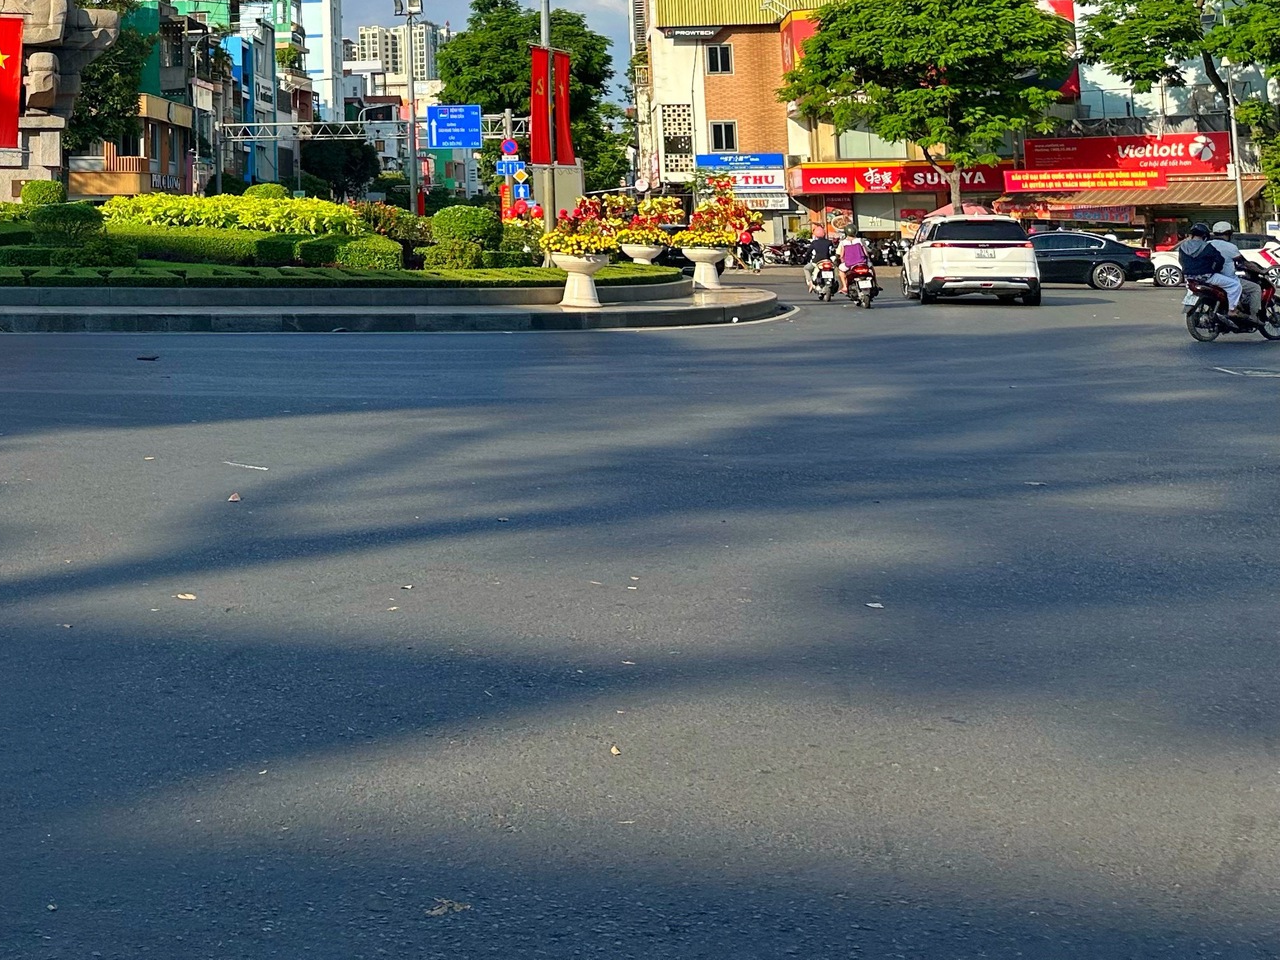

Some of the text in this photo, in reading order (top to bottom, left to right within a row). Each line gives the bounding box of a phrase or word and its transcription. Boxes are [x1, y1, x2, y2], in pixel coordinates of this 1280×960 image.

[1117, 142, 1185, 158] Vietlott
[741, 175, 775, 185] THU
[809, 177, 847, 185] GYUDON
